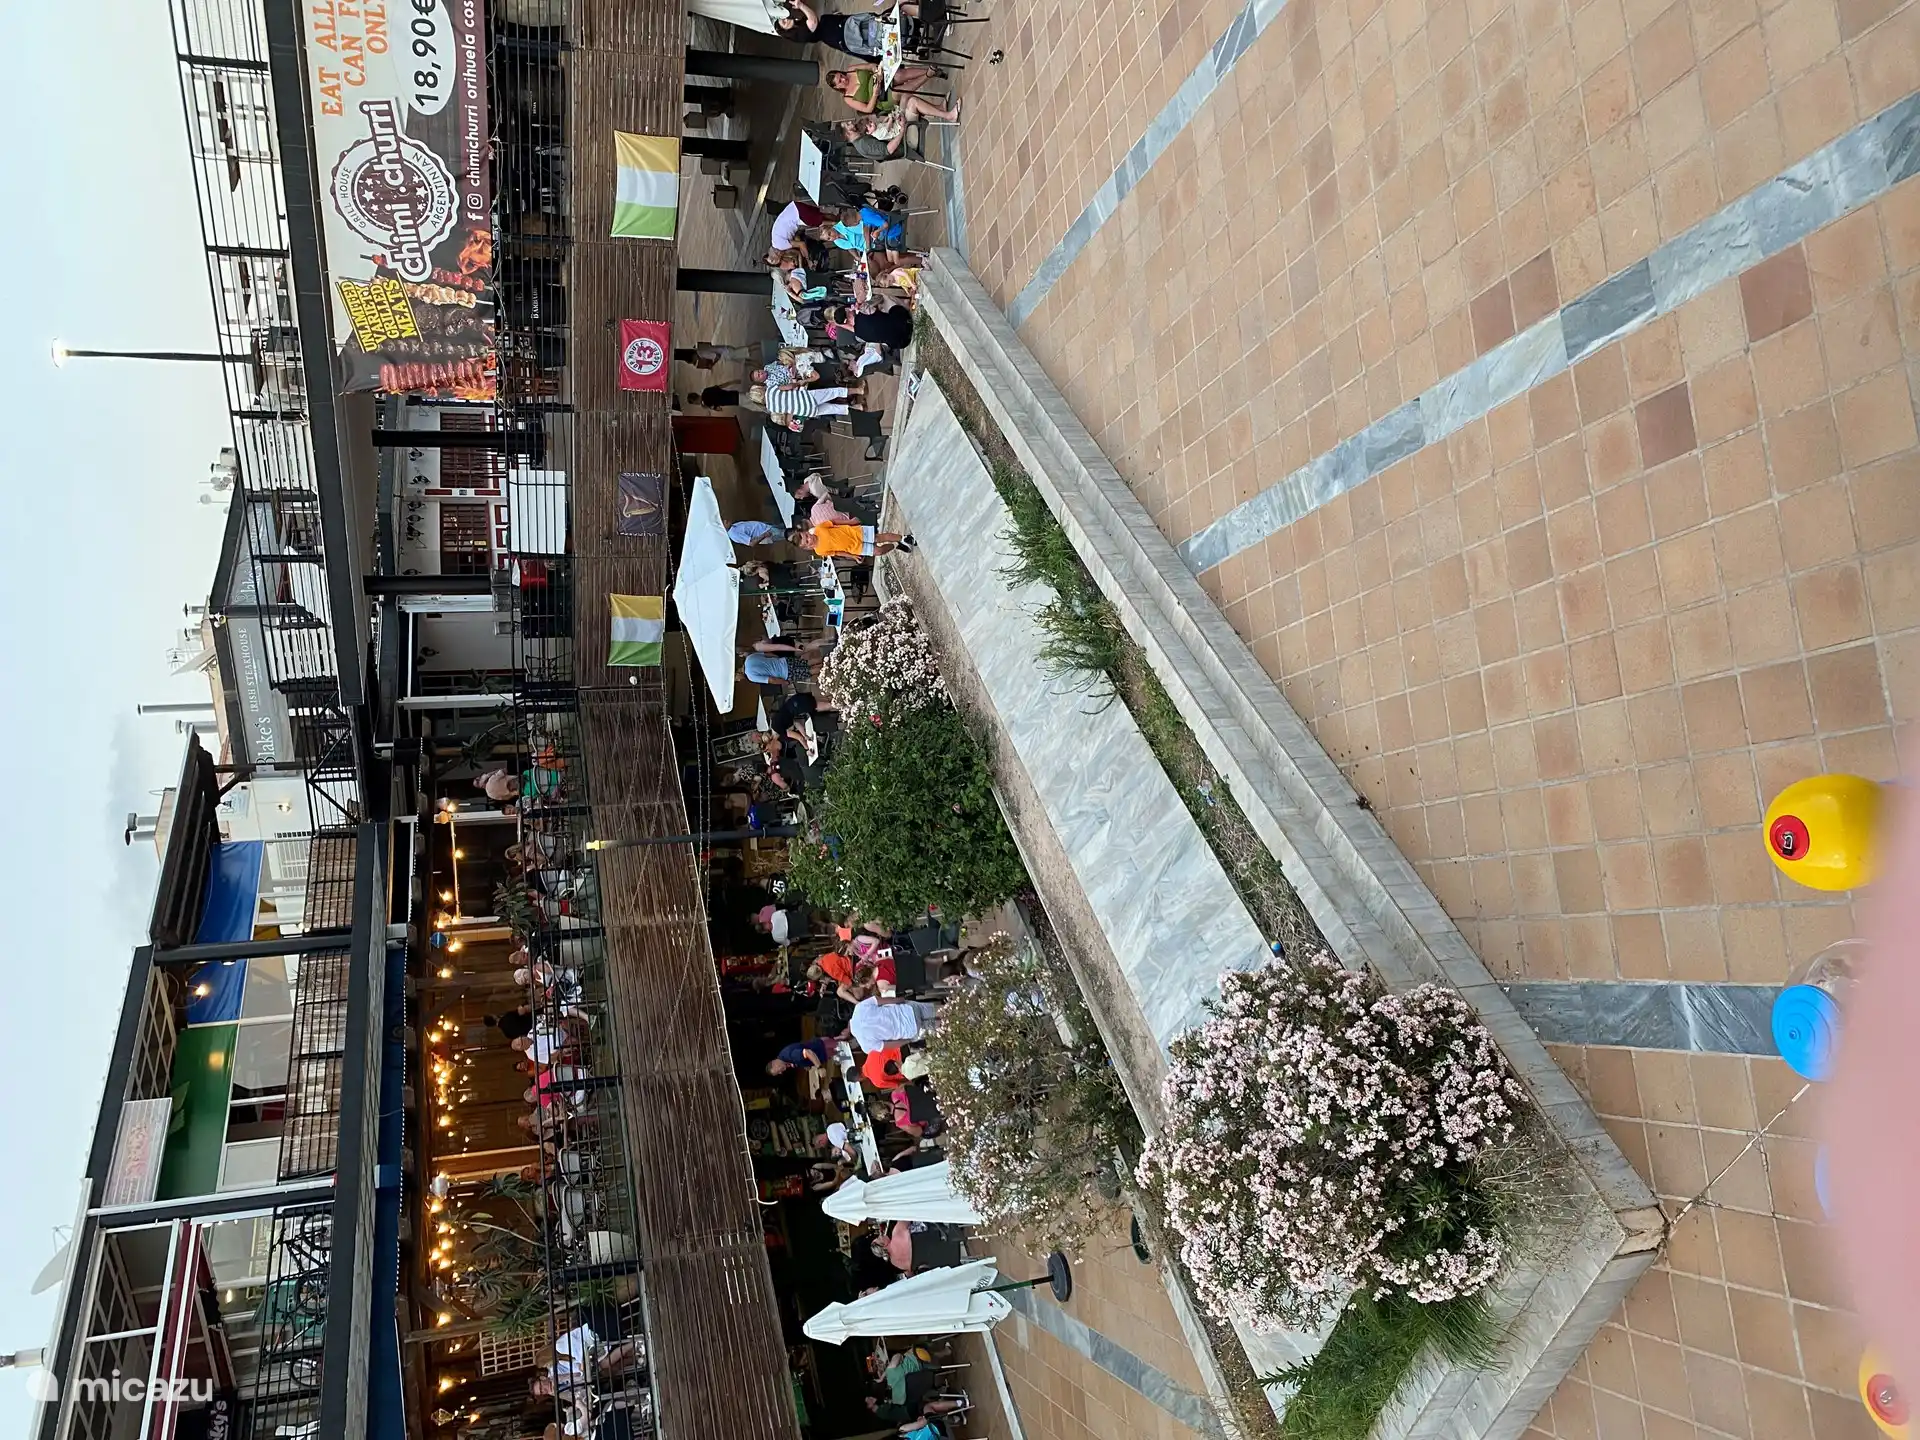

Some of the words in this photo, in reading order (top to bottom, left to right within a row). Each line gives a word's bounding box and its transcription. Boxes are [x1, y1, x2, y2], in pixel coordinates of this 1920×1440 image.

[312, 0, 338, 52] ALL
[337, 0, 360, 18] F
[463, 0, 475, 28] cos
[340, 34, 366, 86] CAN
[410, 0, 442, 107] 18,90€
[460, 33, 478, 99] orihuela
[318, 66, 343, 116] EAT
[464, 104, 481, 187] chimichurri
[339, 165, 352, 199] HOUSE
[412, 151, 446, 228] ARGENTINIAN
[345, 201, 368, 229] GRILL
[384, 203, 424, 274] chimi
[340, 280, 378, 352] UNLIMITED
[355, 284, 387, 344] VARIETY
[370, 283, 400, 339] GRILLED
[383, 279, 417, 338] MEATS
[635, 345, 655, 369] 13
[238, 627, 255, 686] STEAKHOUSE
[247, 688, 259, 712] IRISH
[772, 879, 785, 894] 25
